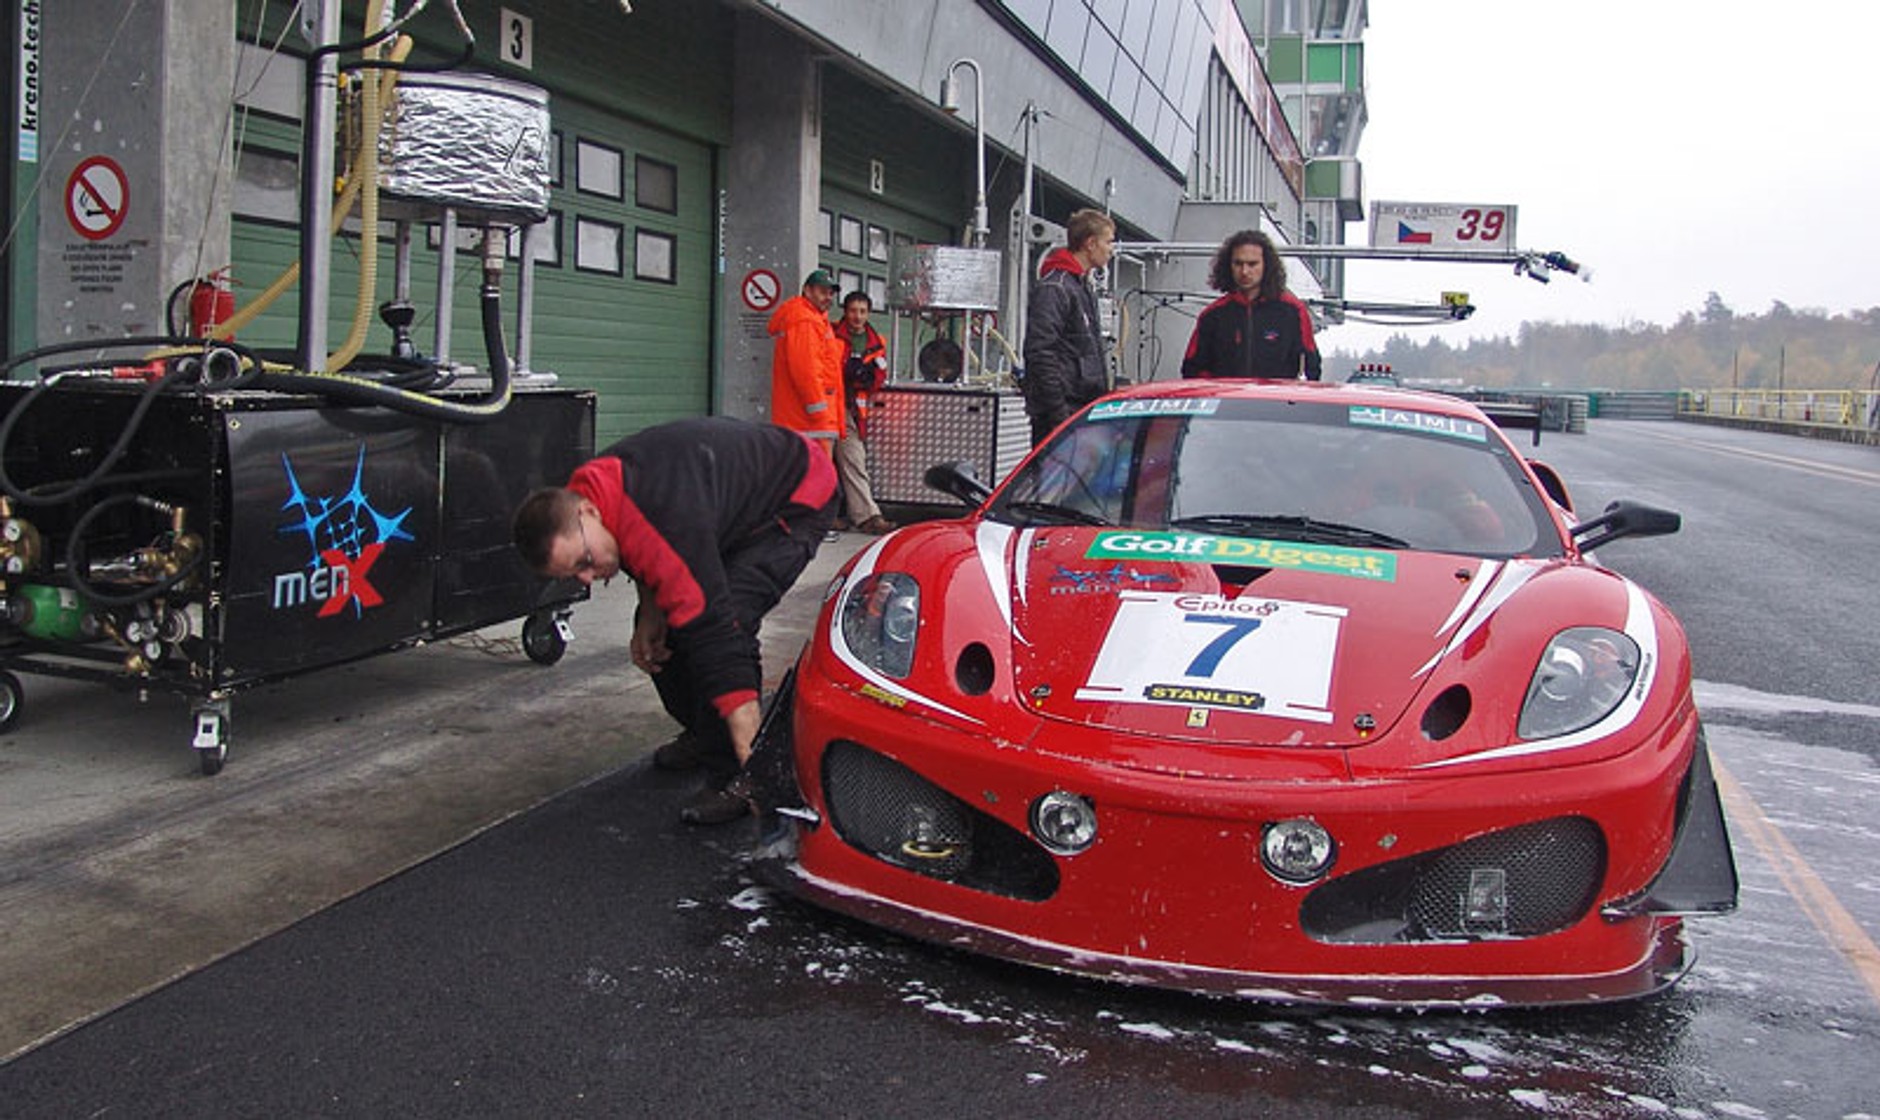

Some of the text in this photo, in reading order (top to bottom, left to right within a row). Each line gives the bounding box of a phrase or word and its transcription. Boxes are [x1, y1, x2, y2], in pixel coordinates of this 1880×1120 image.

[511, 18, 523, 60] 3
[1456, 208, 1505, 241] 39
[1173, 595, 1280, 616] Epilog
[1184, 613, 1262, 678] 7
[1150, 687, 1257, 706] STANLEY
